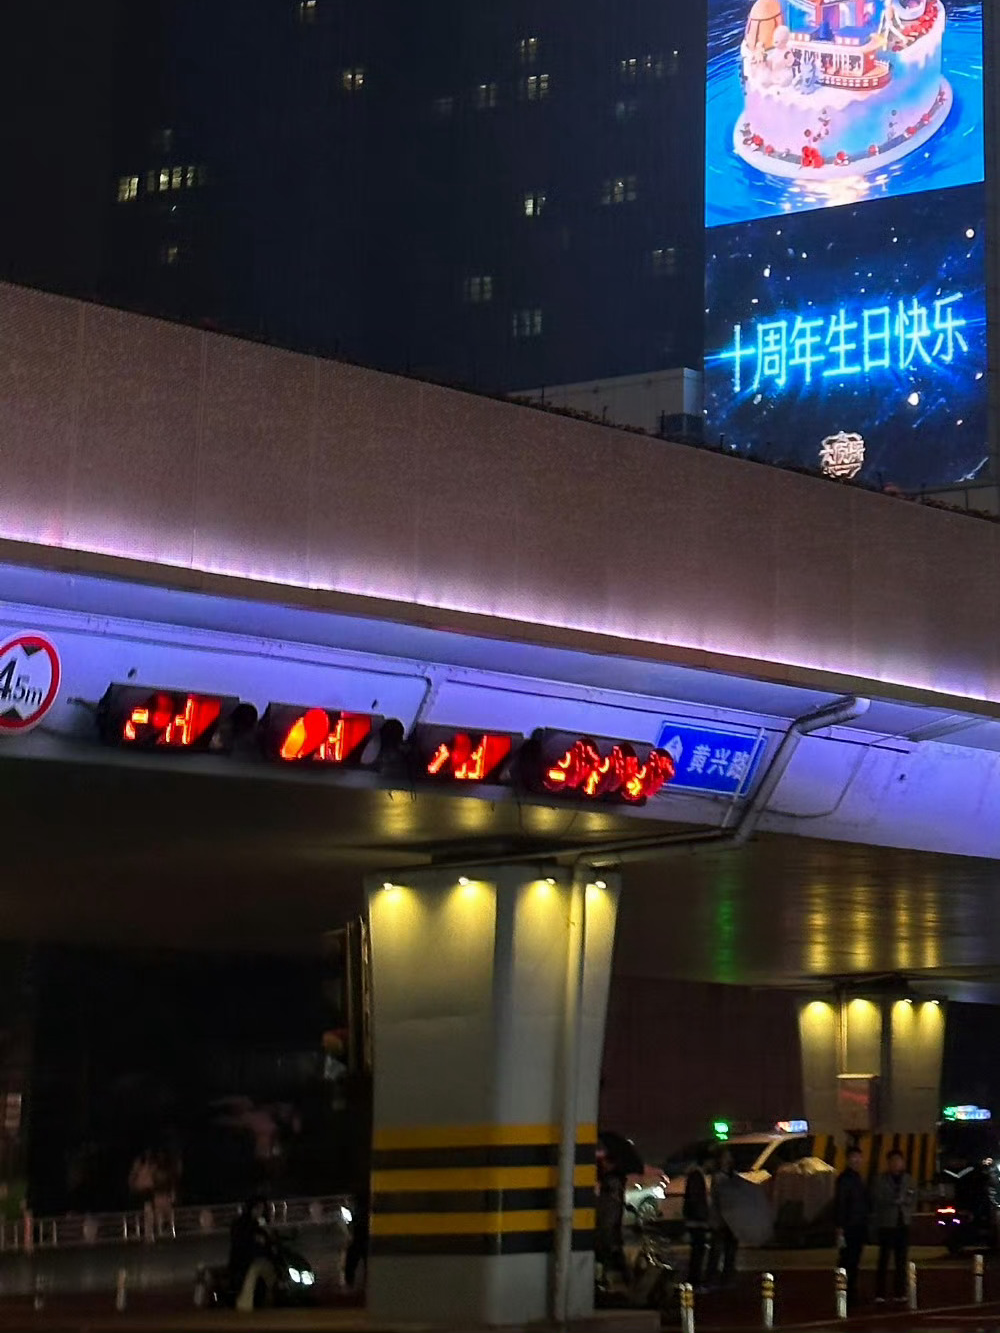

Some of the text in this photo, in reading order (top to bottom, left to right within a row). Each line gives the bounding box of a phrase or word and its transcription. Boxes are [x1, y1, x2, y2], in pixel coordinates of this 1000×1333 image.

[721, 292, 968, 392] 十周年生日快乐
